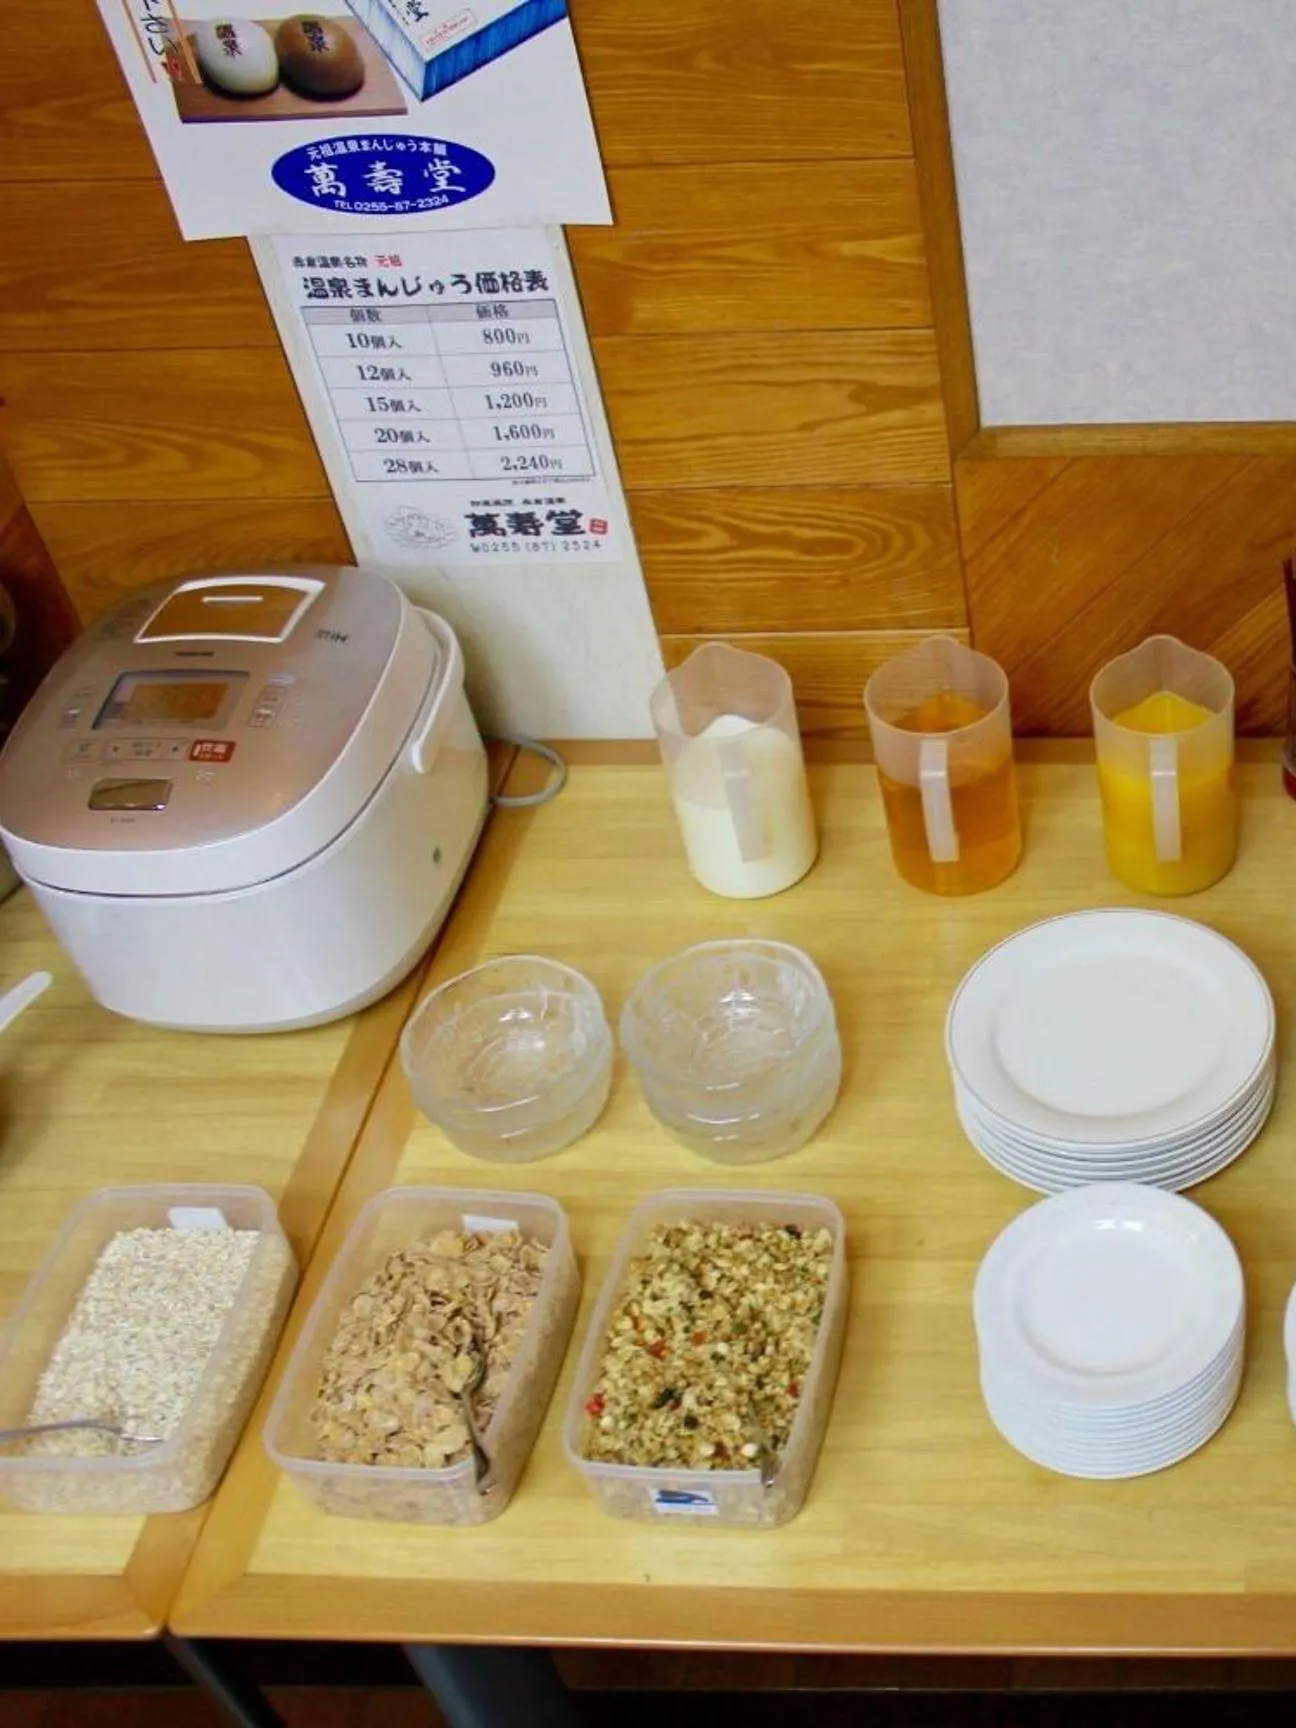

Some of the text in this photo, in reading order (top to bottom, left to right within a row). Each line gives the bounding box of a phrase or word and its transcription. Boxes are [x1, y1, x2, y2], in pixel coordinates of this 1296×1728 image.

[303, 269, 550, 299] 温泉まんじゅう価格表
[476, 304, 509, 319] 価格
[482, 328, 530, 345] 800円
[490, 360, 538, 377] 960円
